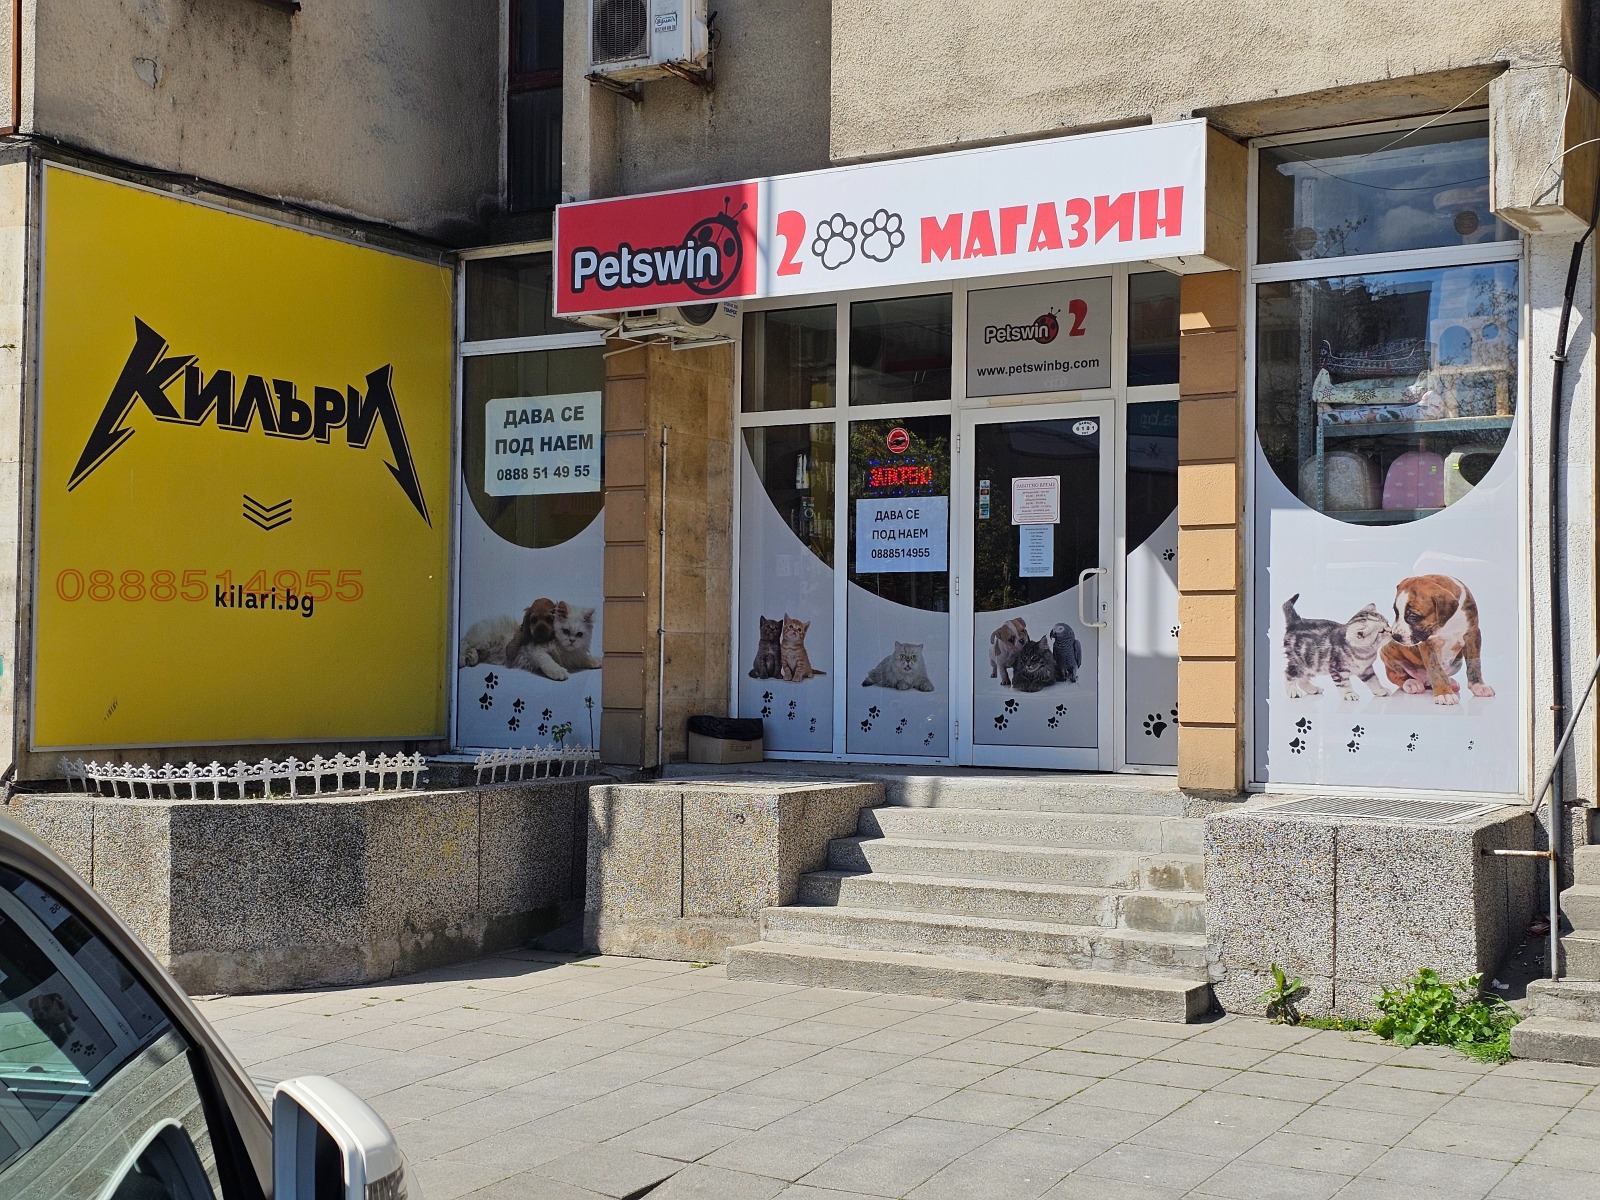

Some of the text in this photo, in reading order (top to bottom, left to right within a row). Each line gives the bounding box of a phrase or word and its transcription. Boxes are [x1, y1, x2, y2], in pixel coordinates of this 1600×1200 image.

[775, 186, 1184, 276] 2 МАГАЗИН
[573, 240, 719, 291] Petswin
[984, 298, 1088, 345] Petswin 2
[977, 357, 1100, 376] www.petswinbg.com
[503, 405, 585, 429] ДАВА СЕ
[495, 433, 594, 456] ПОД НАЕМ
[496, 464, 590, 481] 0888 51 49 55
[874, 509, 920, 522] ДАВА СЕ
[872, 528, 929, 541] ПОД НАЕМ
[871, 547, 931, 559] 0888514955
[56, 568, 364, 602] 0888514955
[214, 584, 315, 618] kilari.bg
